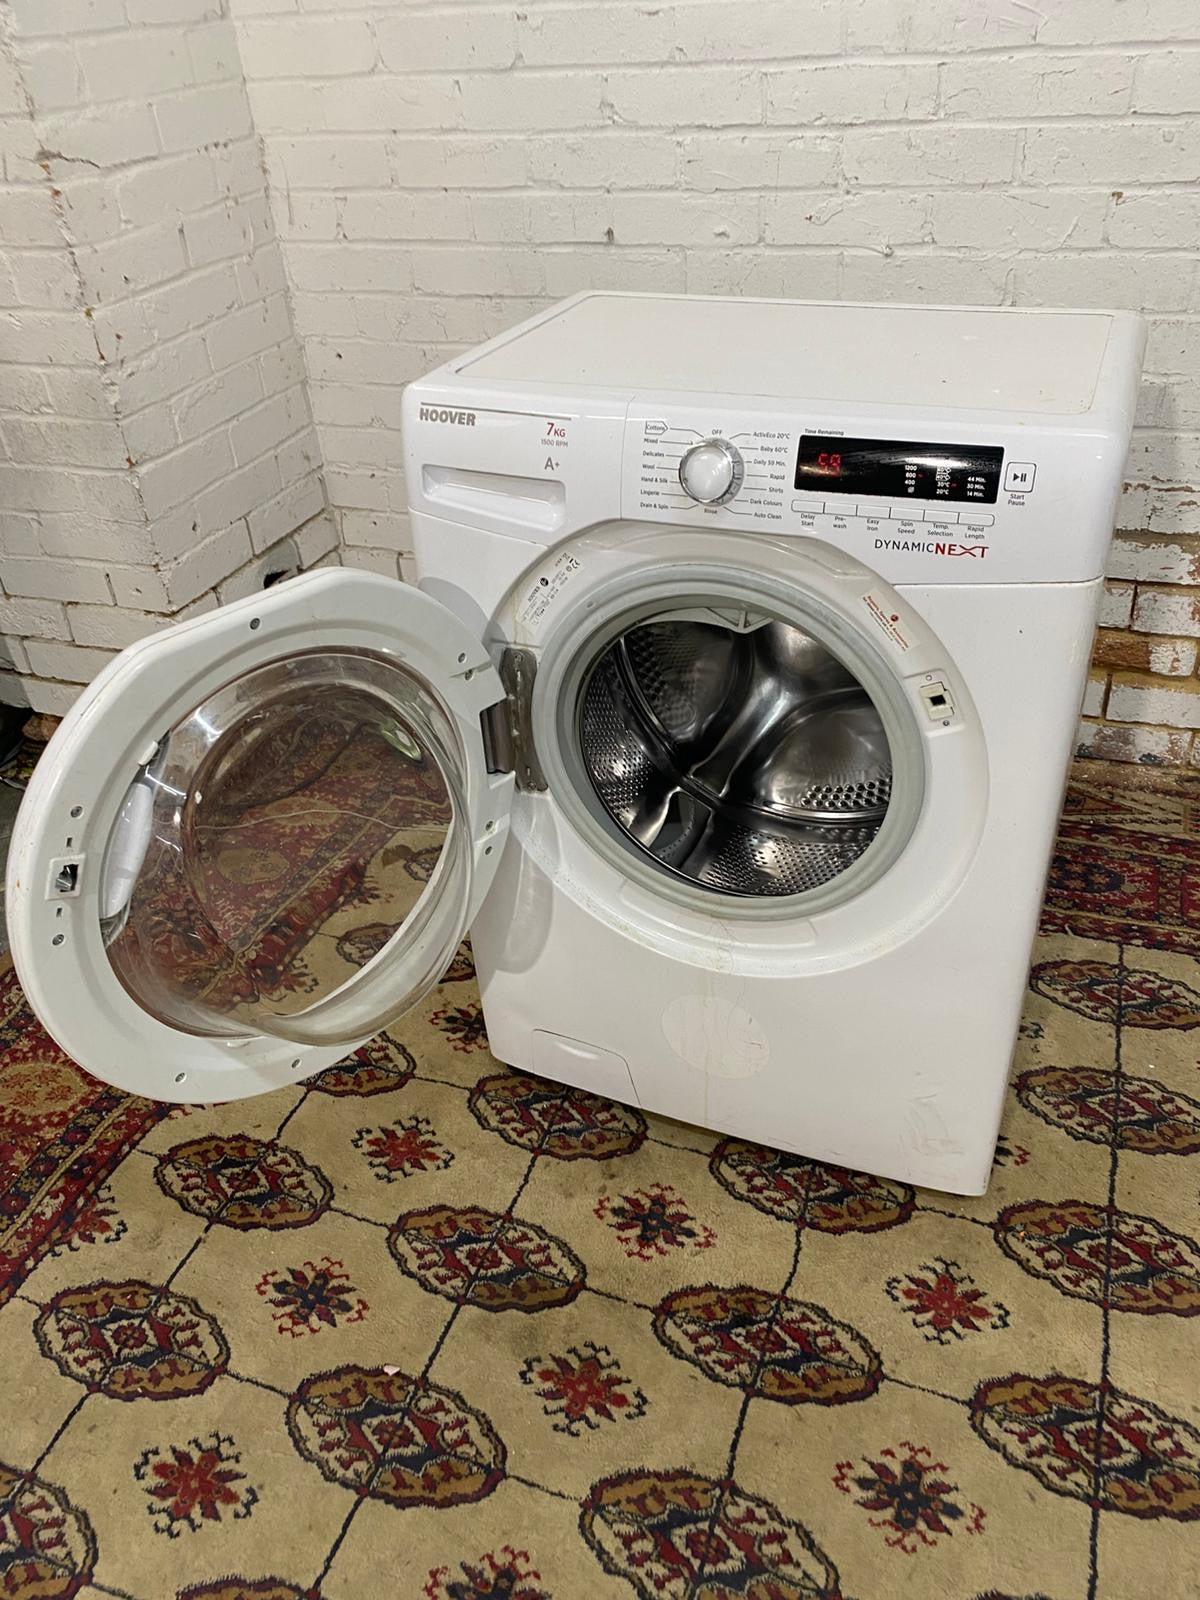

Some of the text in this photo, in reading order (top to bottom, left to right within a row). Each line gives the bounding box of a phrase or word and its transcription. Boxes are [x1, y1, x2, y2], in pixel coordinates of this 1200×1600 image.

[419, 408, 476, 427] HOOVER
[546, 422, 566, 438] 7KG
[753, 431, 776, 439] ActivEco
[555, 439, 569, 448] RPM
[760, 445, 773, 453] Baby
[642, 450, 665, 458] Delicates
[544, 457, 560, 471] A+
[753, 458, 767, 466] Daily
[769, 486, 784, 494] Shirts
[762, 499, 783, 507] Colours
[767, 512, 782, 520] Clean
